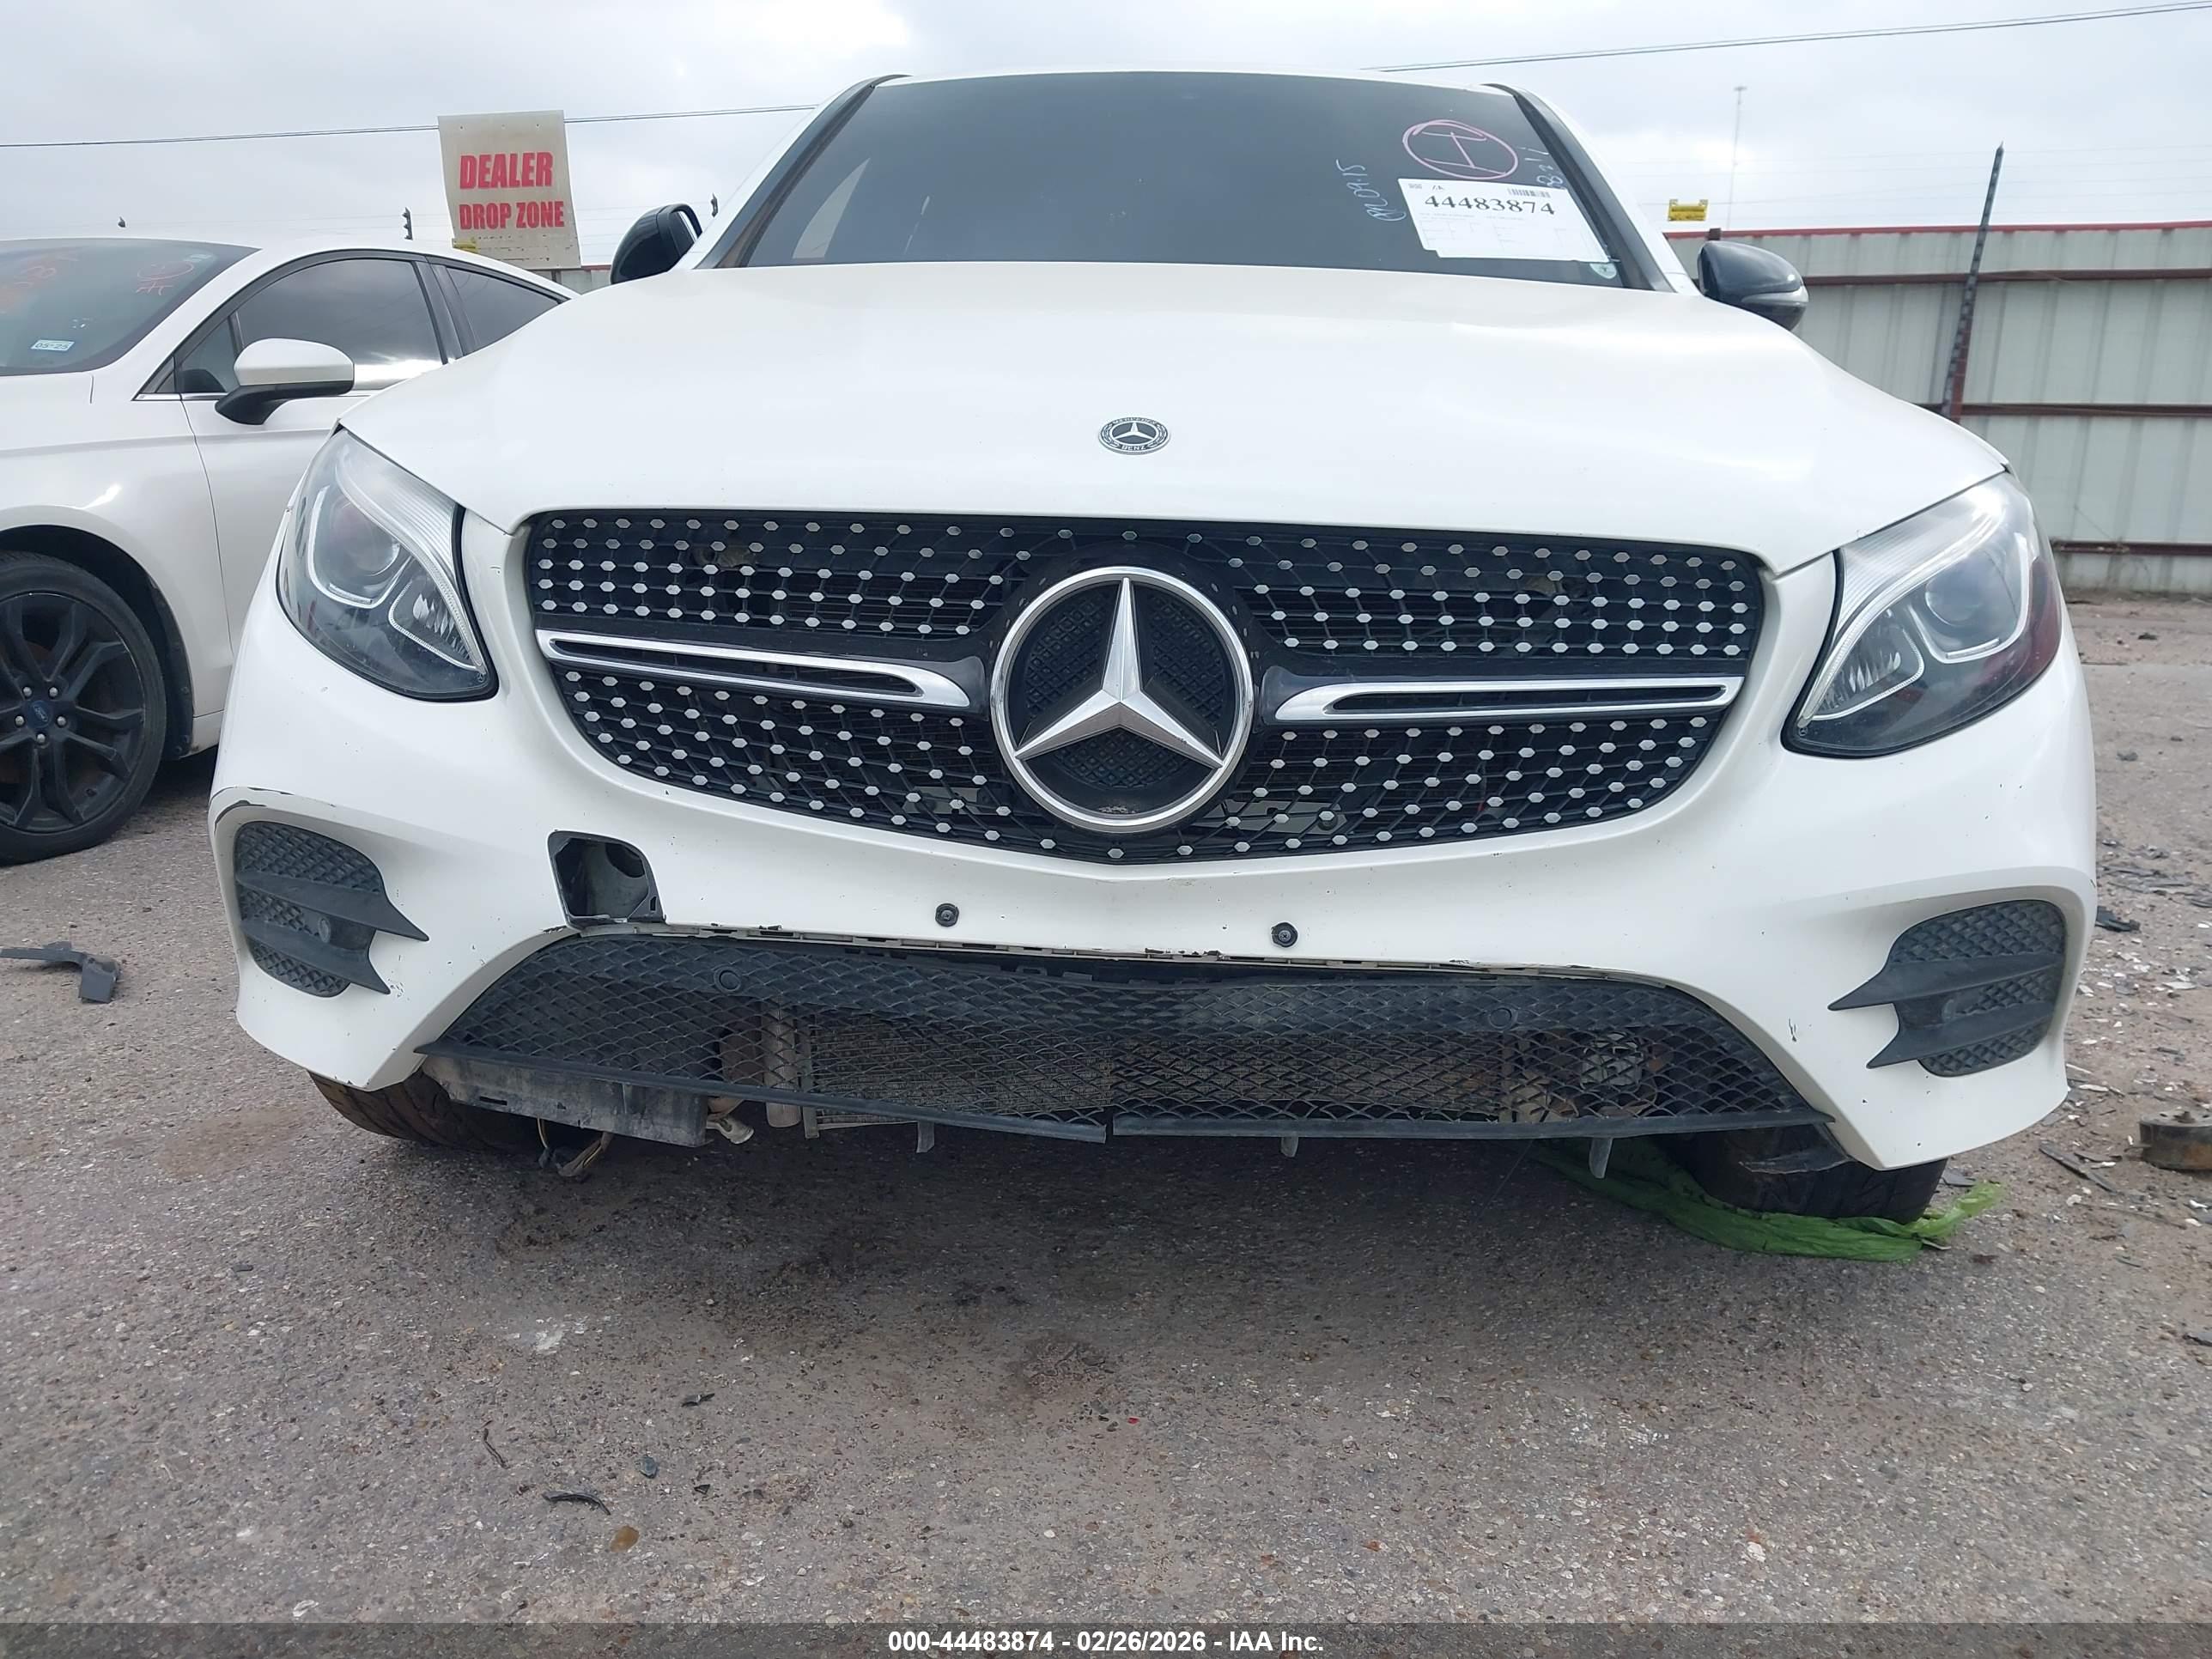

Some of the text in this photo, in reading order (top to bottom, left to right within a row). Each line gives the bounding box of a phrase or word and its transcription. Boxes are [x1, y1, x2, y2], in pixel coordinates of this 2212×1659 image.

[459, 151, 554, 190] DEALER
[459, 200, 565, 230] DROP ZONE
[1425, 195, 1555, 215] 44483874
